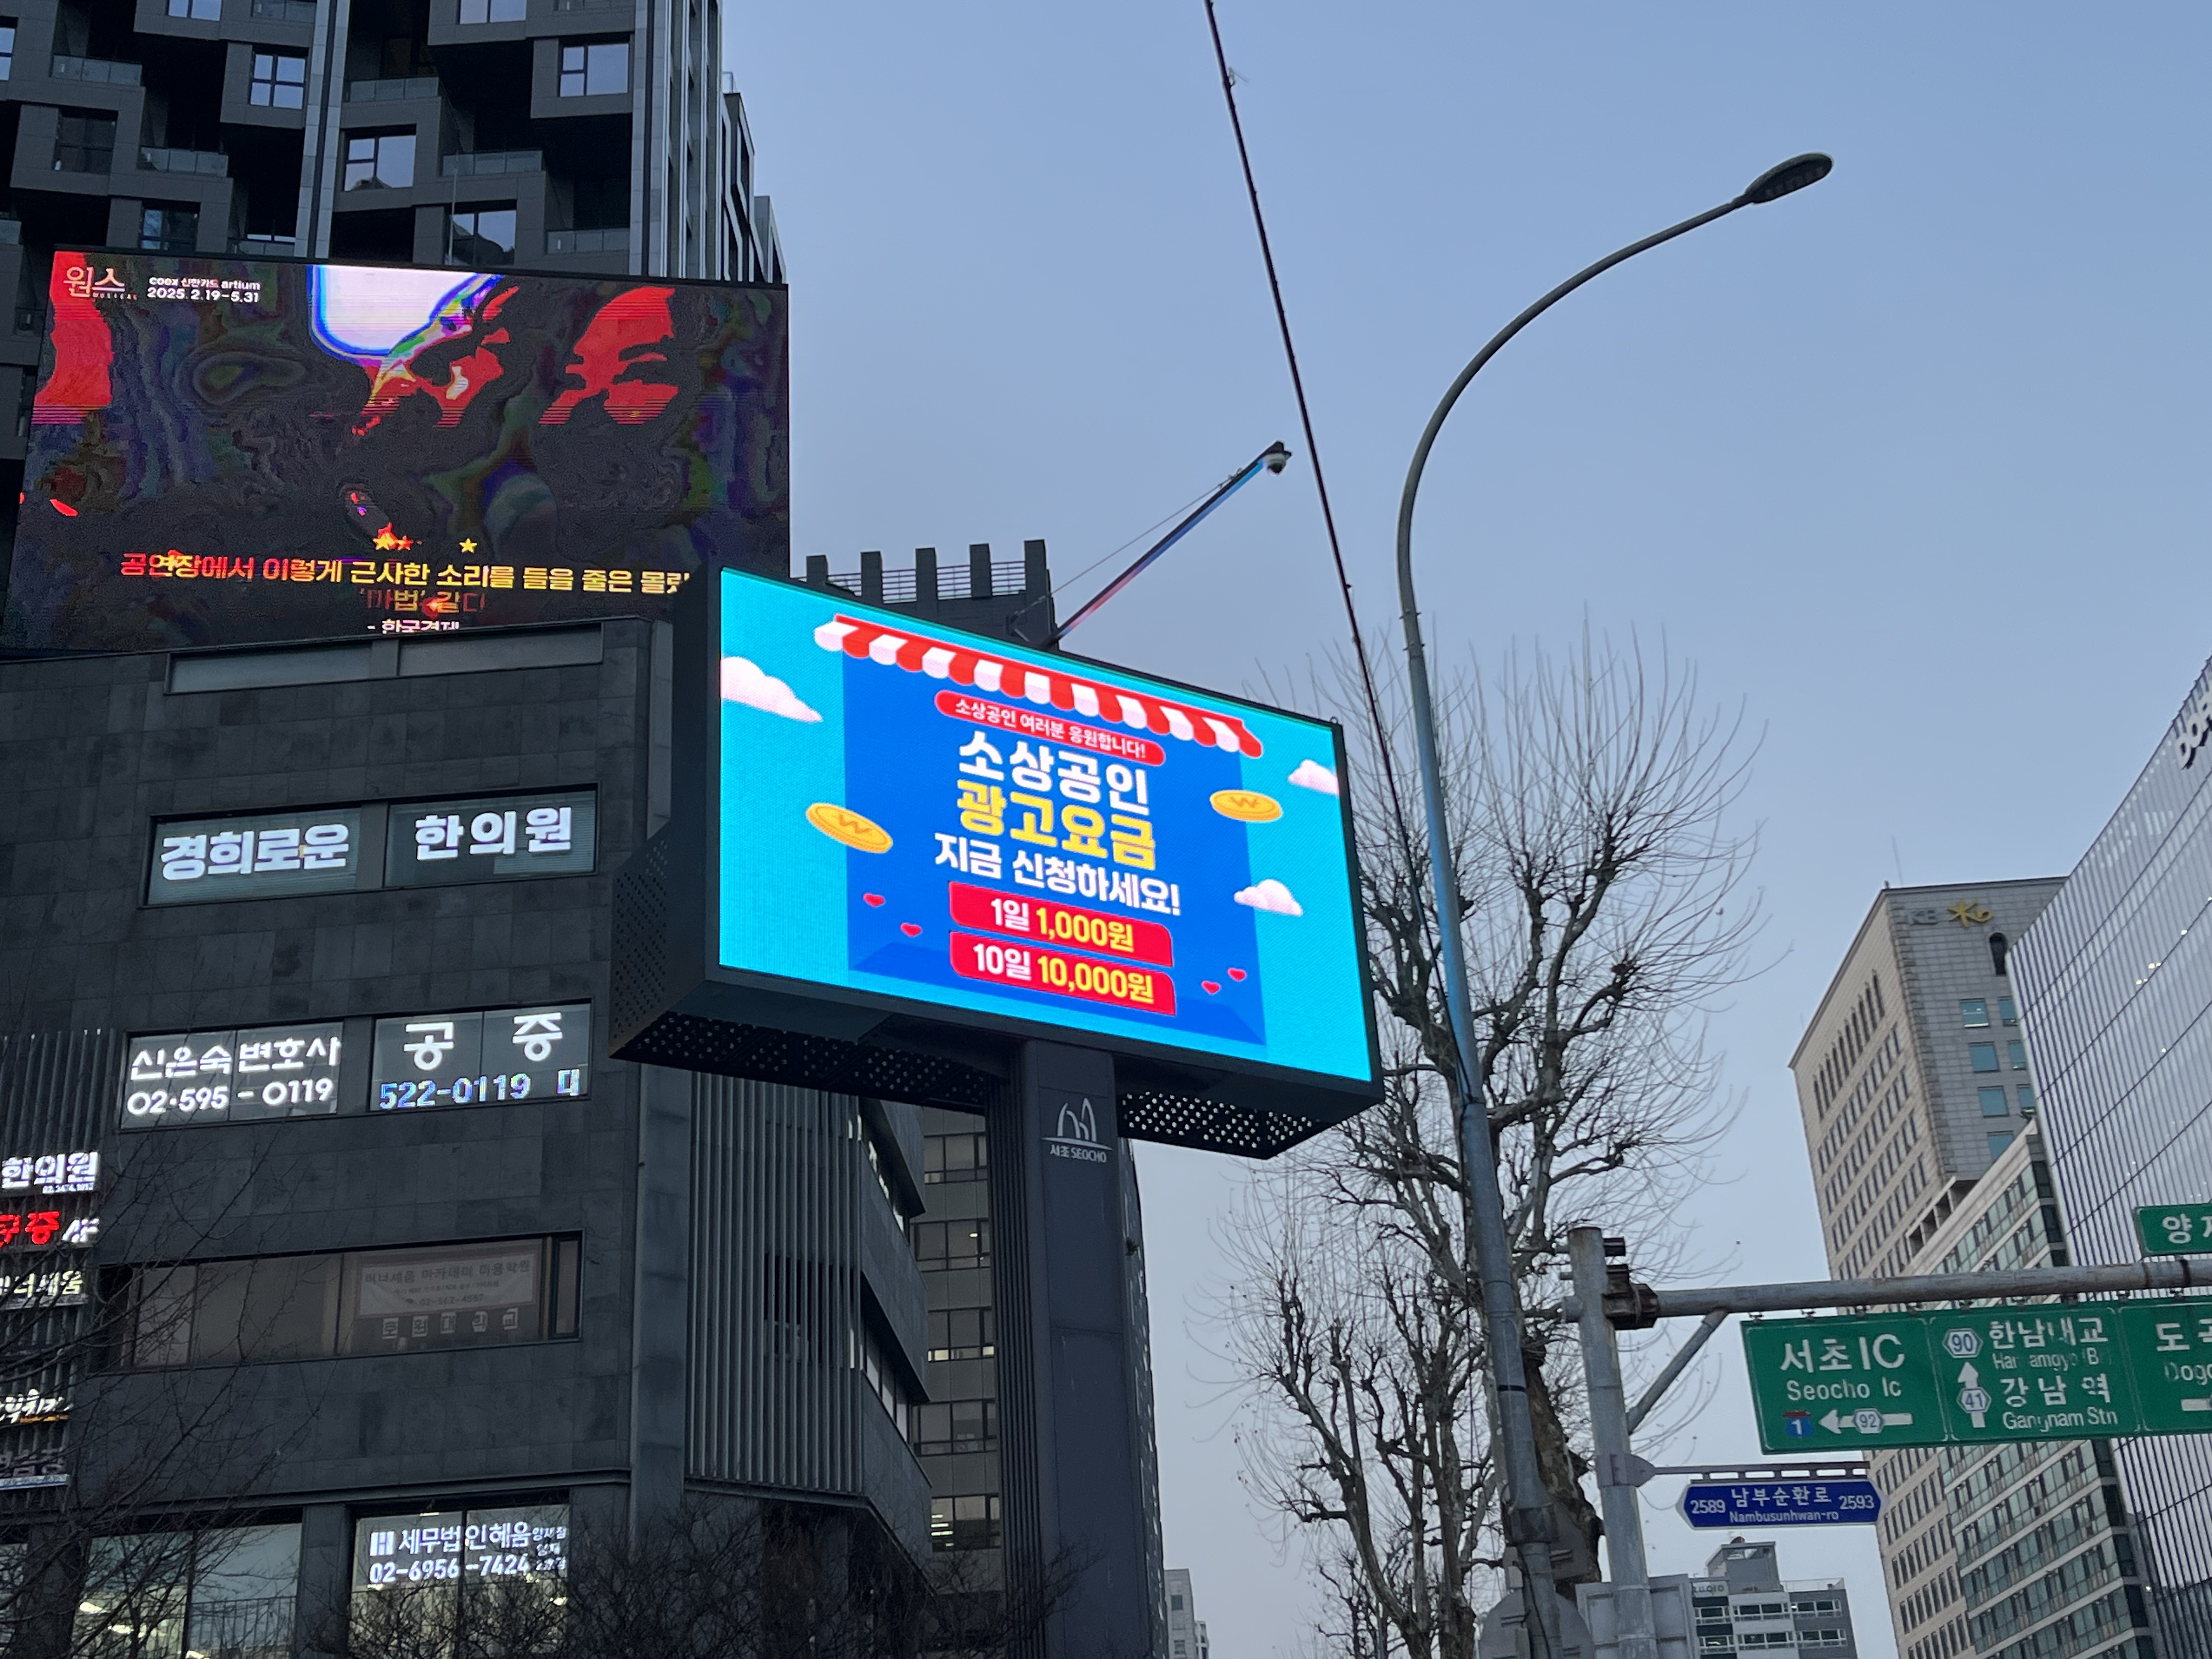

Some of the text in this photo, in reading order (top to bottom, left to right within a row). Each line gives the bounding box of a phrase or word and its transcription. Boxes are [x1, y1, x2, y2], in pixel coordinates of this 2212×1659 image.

[63, 267, 126, 298] 원스
[221, 280, 260, 290] artium
[121, 552, 255, 580] 공연장에서
[262, 559, 343, 583] 이렇게
[351, 561, 431, 586] 근사한
[436, 565, 515, 589] 소리를
[522, 567, 574, 591] 들을
[582, 568, 633, 593] 줄은
[955, 698, 1146, 759] 소상공인 여러분 응원합니다!
[959, 730, 1149, 816] 소상공인
[957, 780, 1155, 870] 광고요금
[160, 806, 572, 881] 경희로운 한의원
[934, 833, 1181, 916] 지금 신청하세요!
[990, 899, 1134, 952] 1일 1,000원
[973, 943, 1154, 1004] 10일 10,000원
[380, 1073, 531, 1109] 522-0119
[1050, 1144, 1107, 1163] 서초 SEOCHO
[2, 1152, 98, 1189] 한의원
[1780, 1334, 1905, 1373] 서초IC
[1953, 1334, 1973, 1352] 90
[1786, 1376, 1901, 1401] Seocho Ic
[1965, 1392, 1984, 1407] 41
[1791, 1419, 1803, 1435] 1
[1859, 1414, 1877, 1428] 92
[2087, 1407, 2118, 1425] Stn
[1690, 1499, 1726, 1514] 2589
[1731, 1486, 1832, 1508] 남부순환로
[1839, 1495, 1875, 1510] 2593
[1729, 1510, 1839, 1523] Nambusunhwan-ro
[370, 1553, 530, 1583] 02-6956-7424
